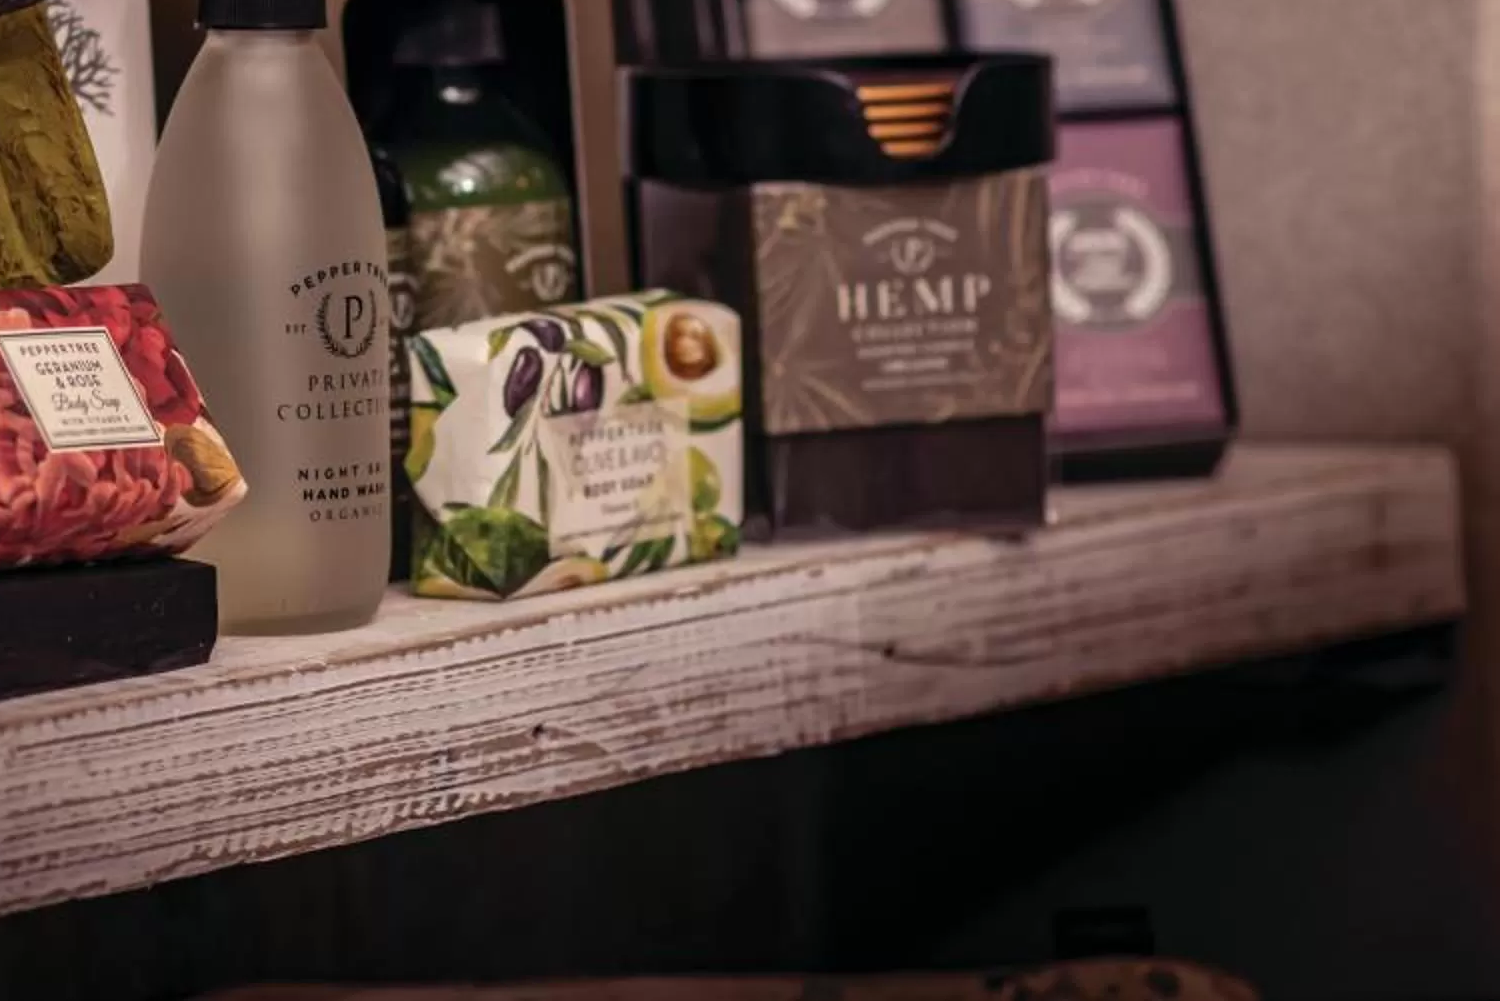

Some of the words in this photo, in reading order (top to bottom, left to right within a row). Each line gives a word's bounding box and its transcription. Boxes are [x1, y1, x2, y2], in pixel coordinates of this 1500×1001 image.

[290, 261, 361, 298] PEPPER
[837, 273, 991, 322] HEMP
[344, 295, 363, 339] P
[19, 342, 100, 356] PEPPERTREE
[35, 359, 103, 375] GERANIUM
[55, 377, 65, 389] &
[69, 373, 102, 388] ROSE
[51, 391, 88, 415] Body
[277, 398, 386, 421] COLLECTI
[298, 464, 359, 481] NIGHT
[303, 486, 350, 501] HAND
